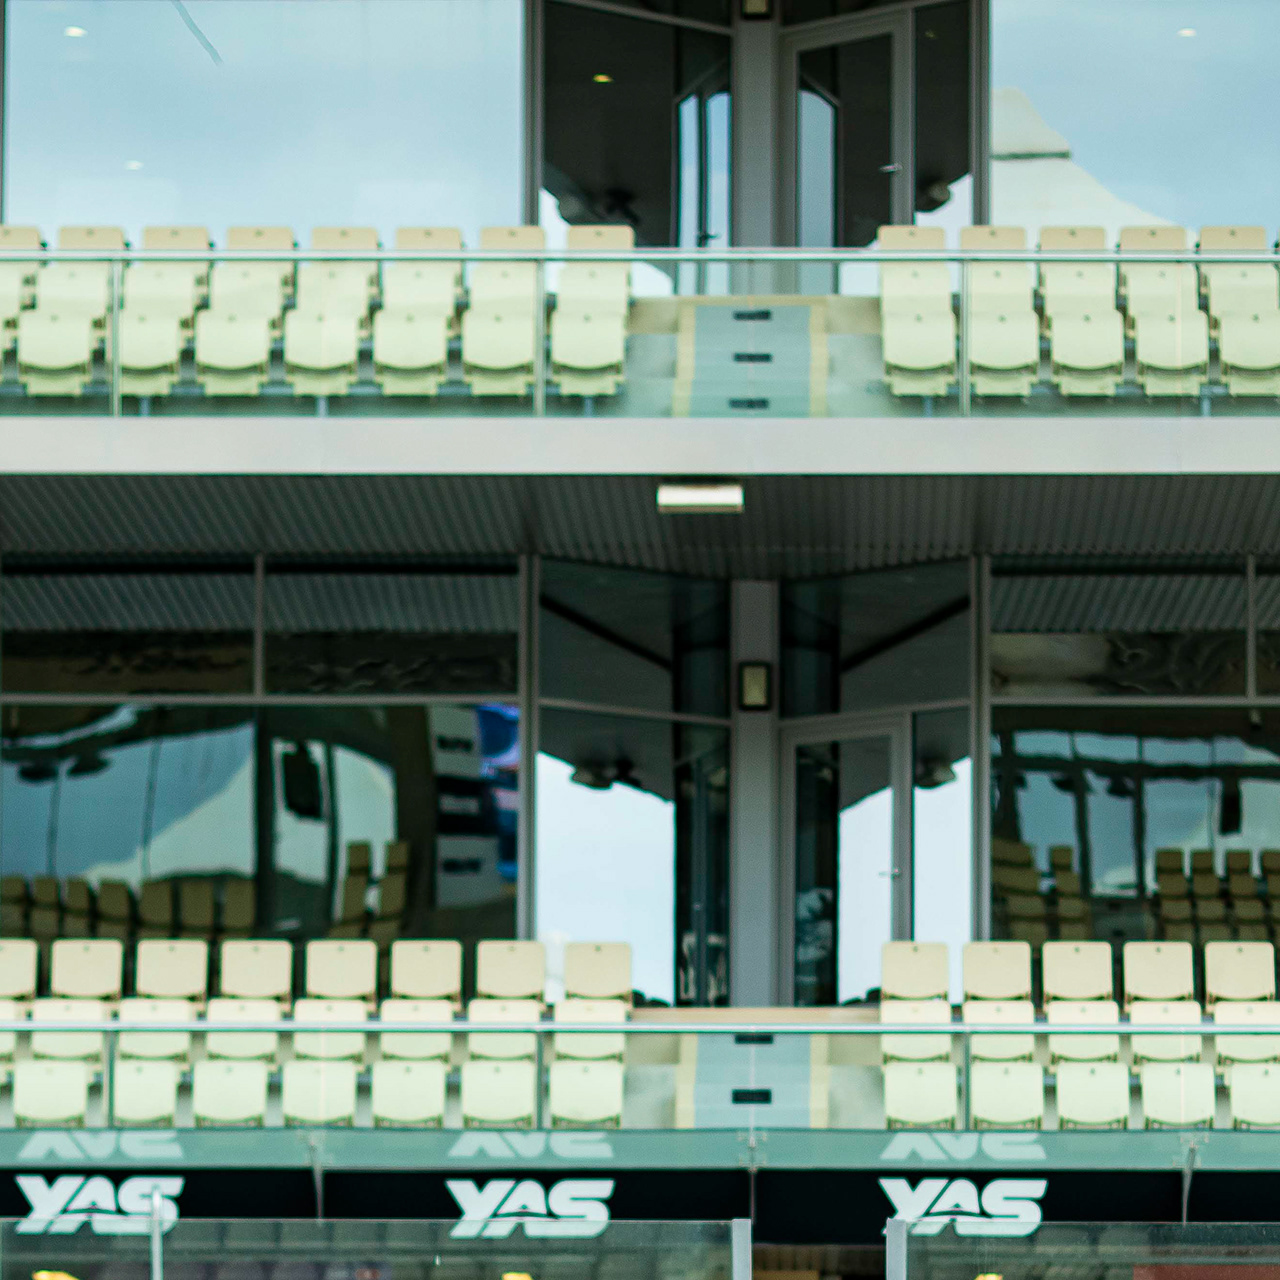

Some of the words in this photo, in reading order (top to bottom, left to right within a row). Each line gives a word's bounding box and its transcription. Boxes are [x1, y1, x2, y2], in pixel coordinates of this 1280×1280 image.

[16, 1175, 184, 1234] YAS
[446, 1180, 615, 1238] YAS
[878, 1179, 1048, 1237] YAS
